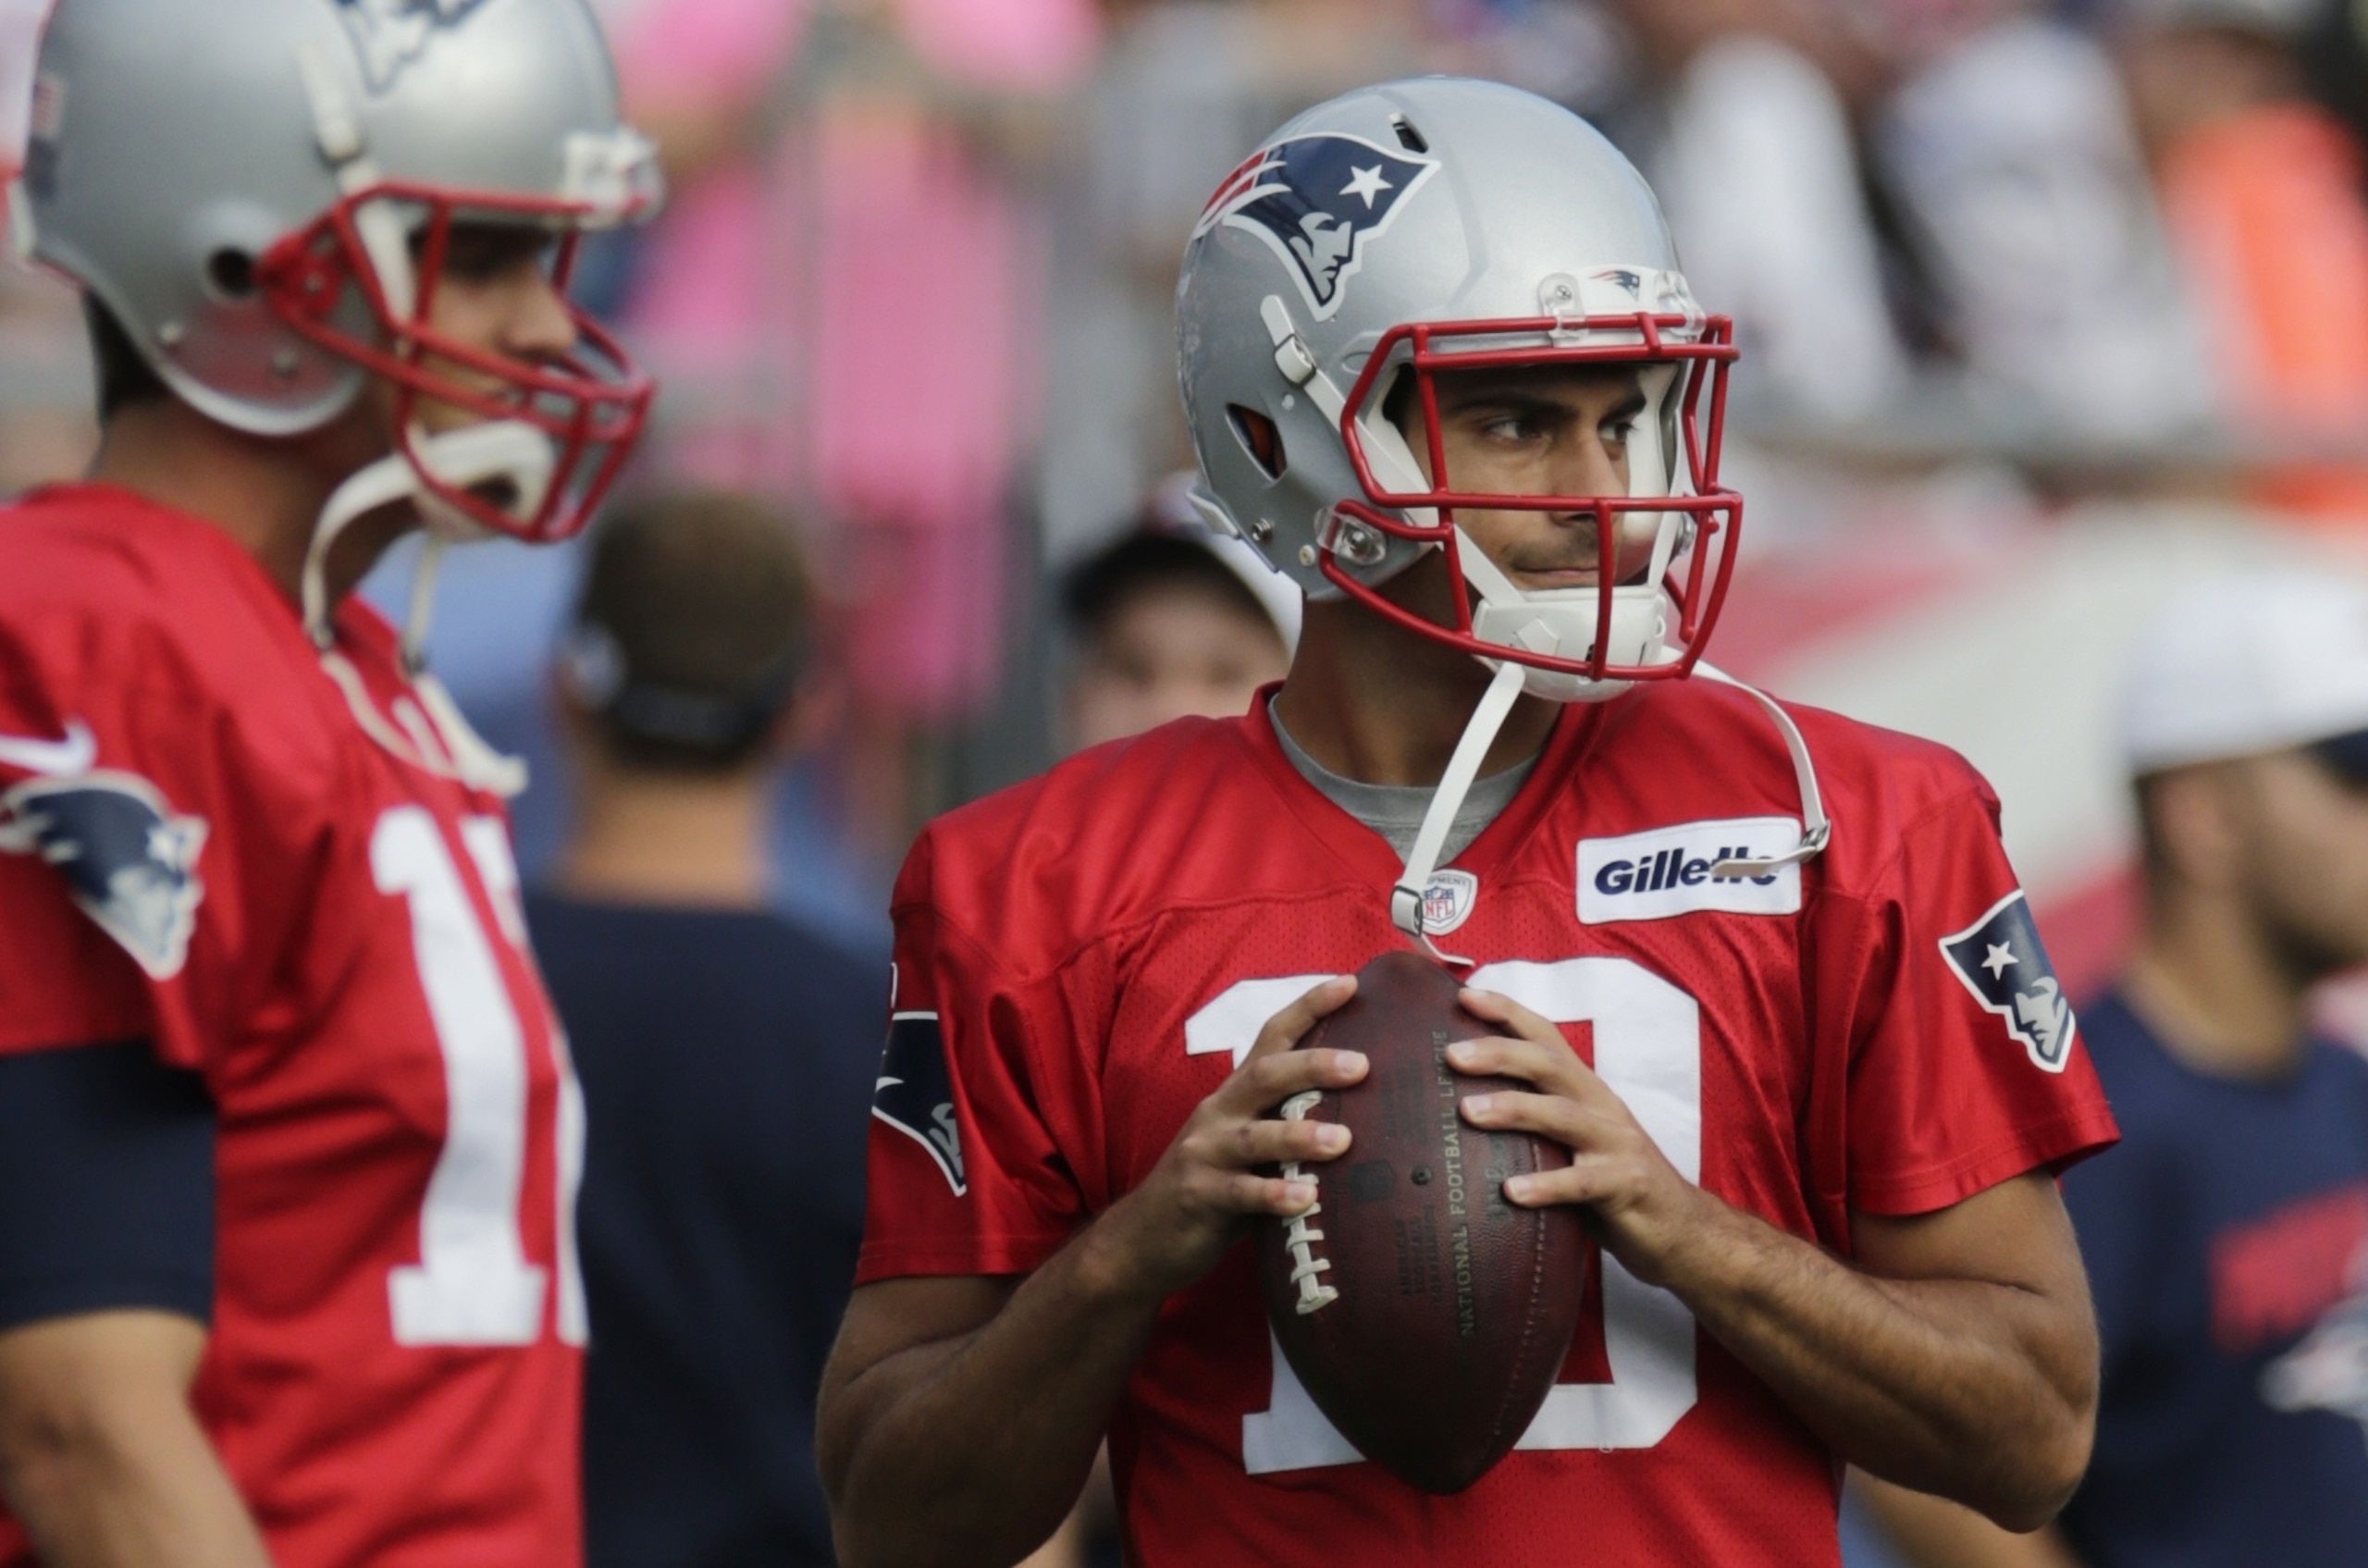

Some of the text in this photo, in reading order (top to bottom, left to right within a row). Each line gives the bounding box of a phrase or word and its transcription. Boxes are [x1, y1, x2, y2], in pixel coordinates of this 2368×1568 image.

[1424, 899, 1452, 919] NFL
[371, 804, 589, 1348] 1
[1432, 1030, 1475, 1336] NATIONAL FOOTBALL LEGUE
